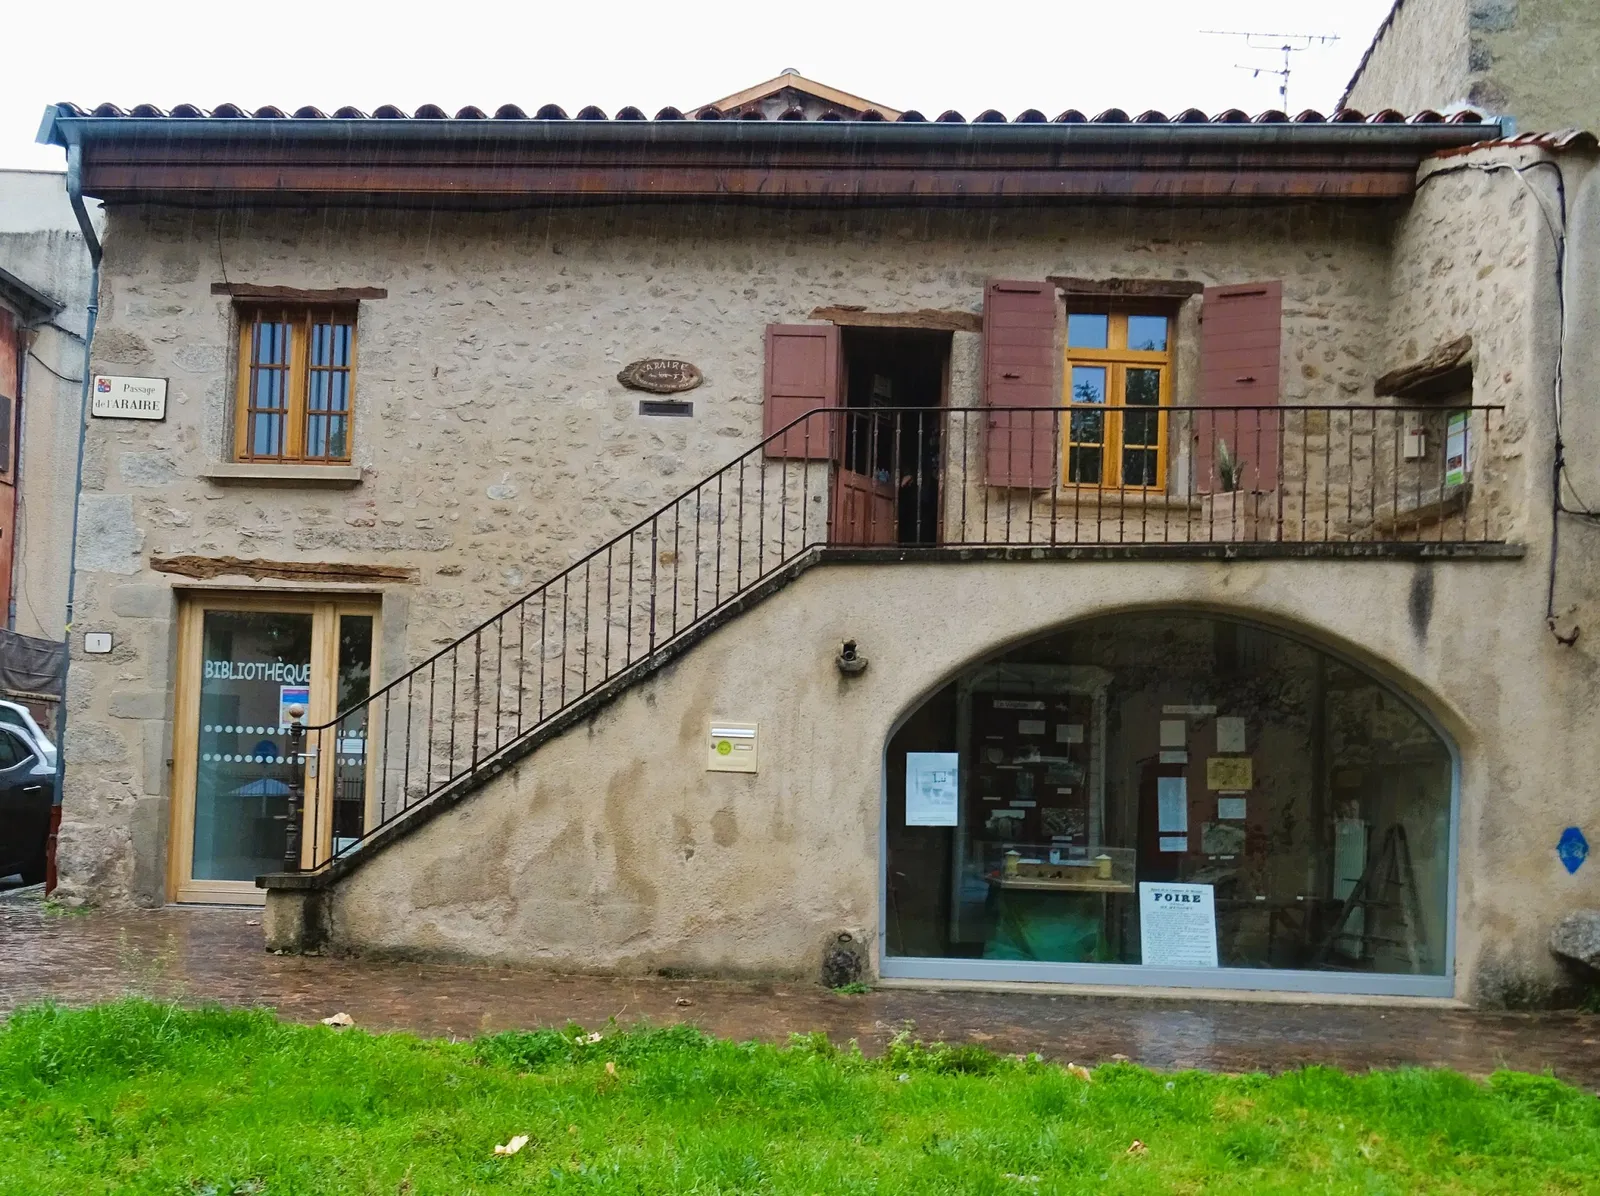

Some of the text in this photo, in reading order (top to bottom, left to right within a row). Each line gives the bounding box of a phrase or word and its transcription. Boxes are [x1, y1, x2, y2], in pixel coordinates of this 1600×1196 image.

[123, 383, 156, 395] Passage
[95, 399, 160, 411] de l'ARAIRE
[205, 656, 311, 685] BIBLIOTHÈQUE
[1154, 893, 1201, 903] FOIRE
